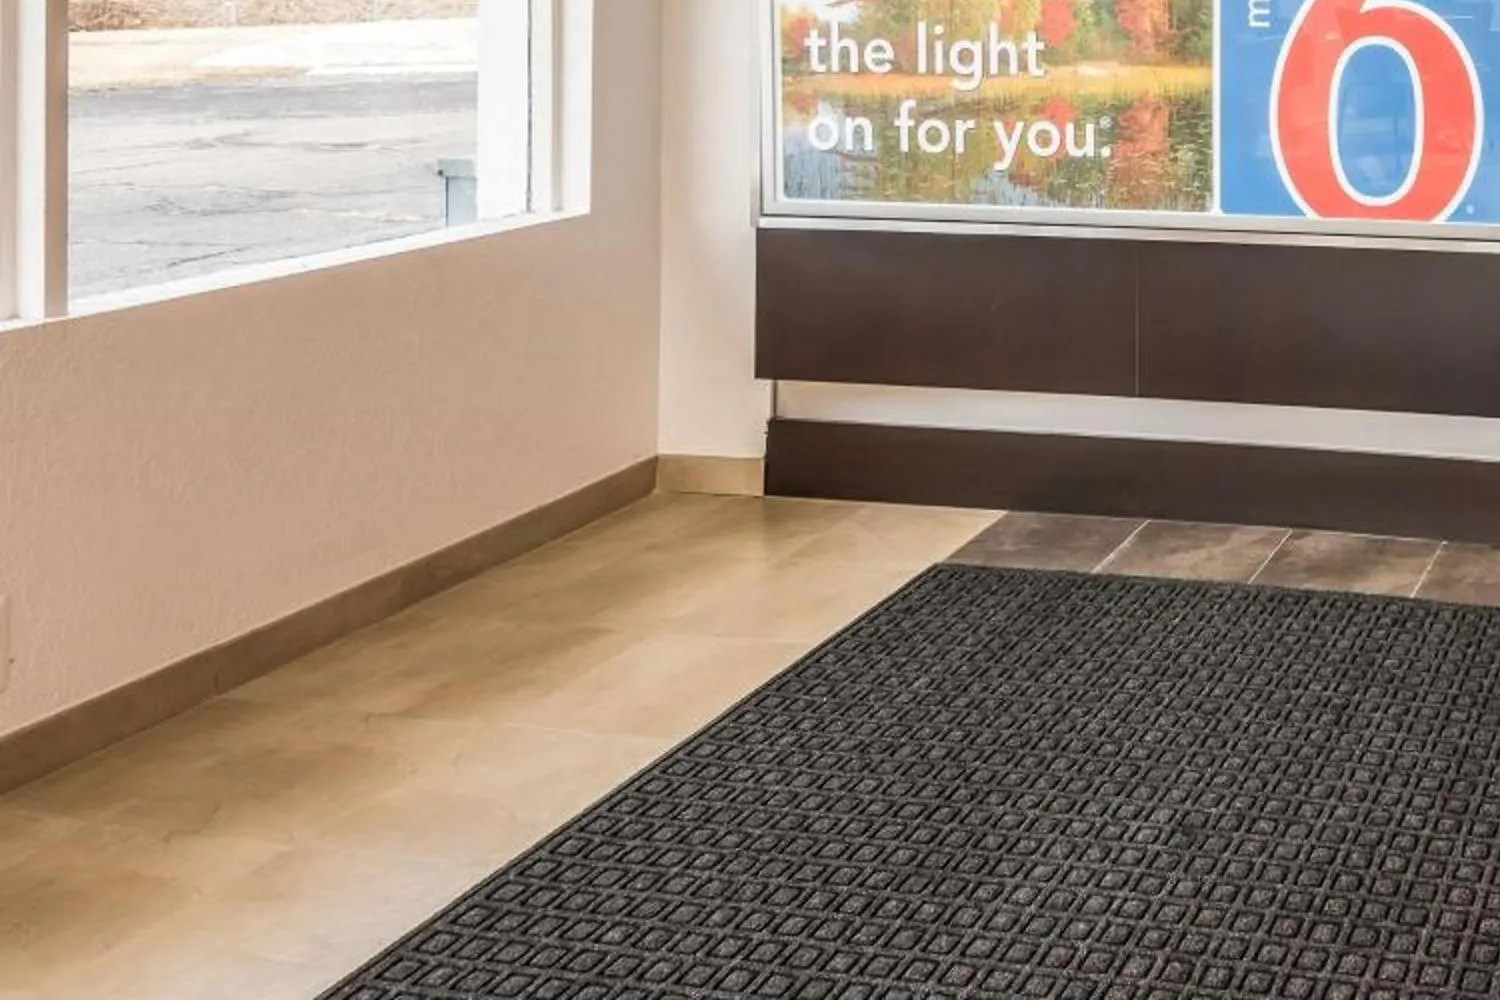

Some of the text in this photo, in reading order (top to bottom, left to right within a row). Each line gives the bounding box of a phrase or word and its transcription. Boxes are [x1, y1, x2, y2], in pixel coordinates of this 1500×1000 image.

[804, 20, 1046, 92] the light
[807, 111, 875, 153] on
[893, 99, 977, 155] for
